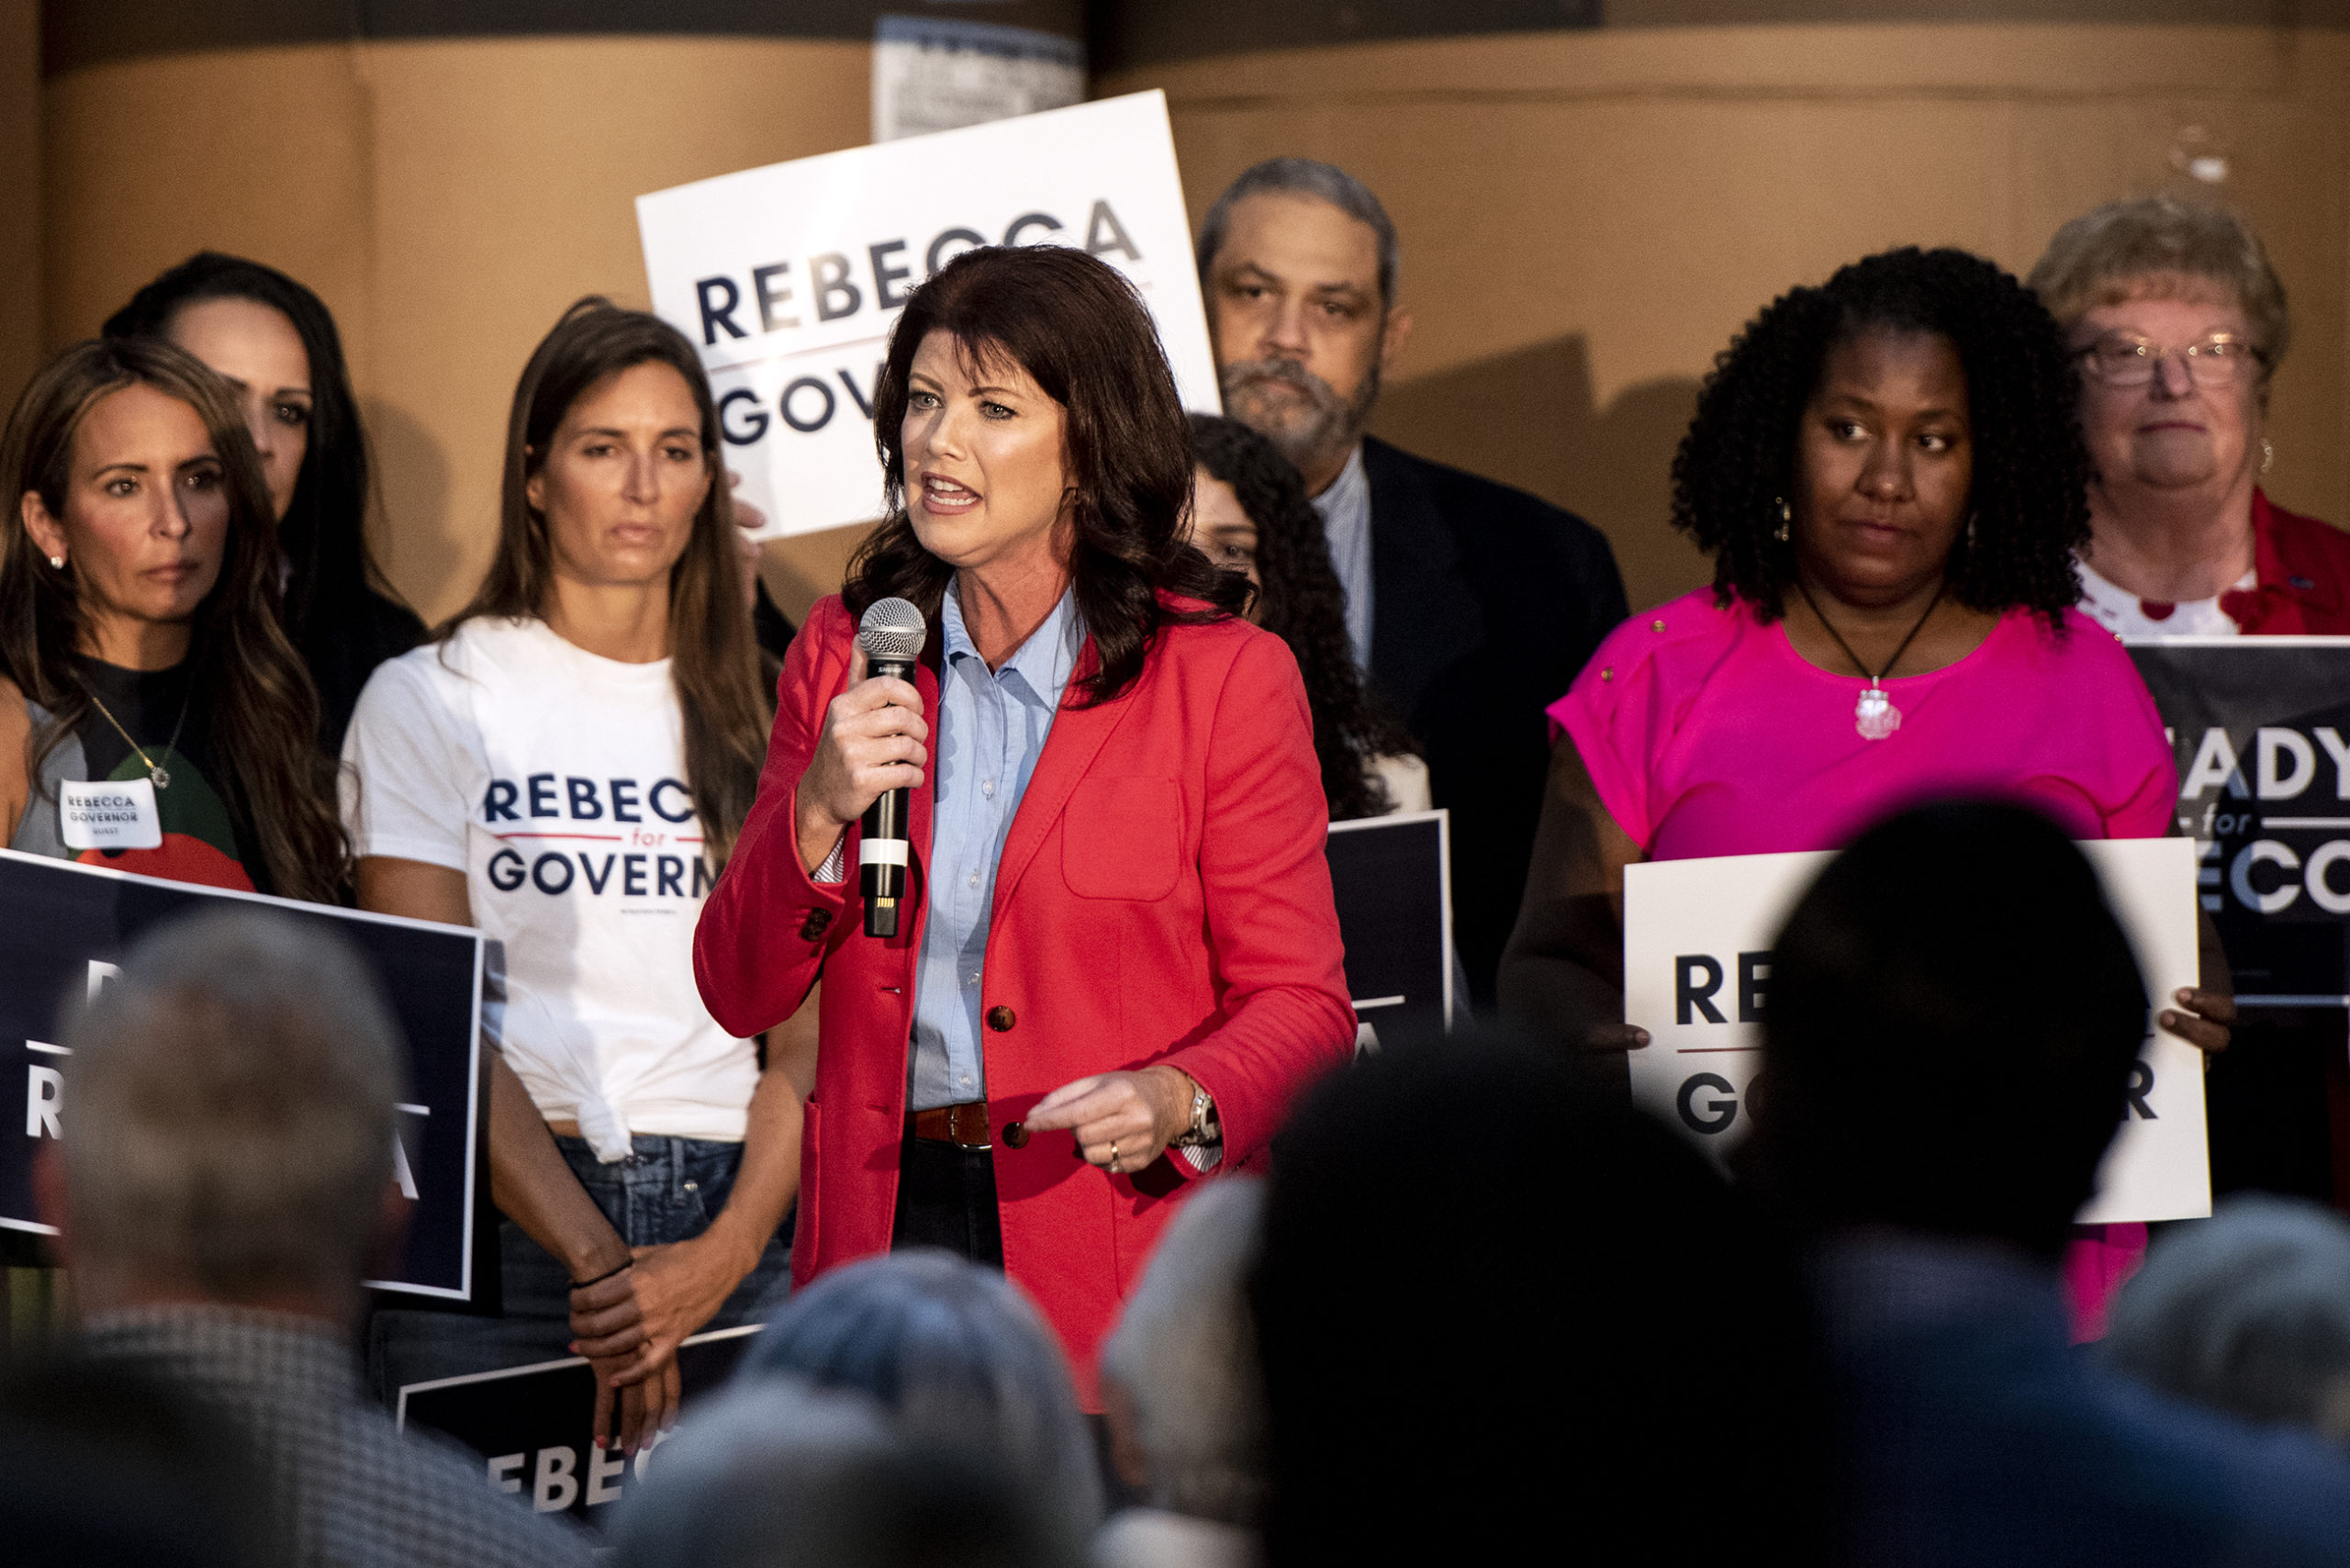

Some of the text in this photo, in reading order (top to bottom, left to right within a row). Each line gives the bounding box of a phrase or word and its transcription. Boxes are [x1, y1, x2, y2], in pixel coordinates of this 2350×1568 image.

[2165, 726, 2350, 800] ADY
[68, 796, 135, 807] REBECCA
[70, 812, 139, 823] GOVERNOR
[2203, 802, 2252, 836] for
[631, 828, 666, 847] for
